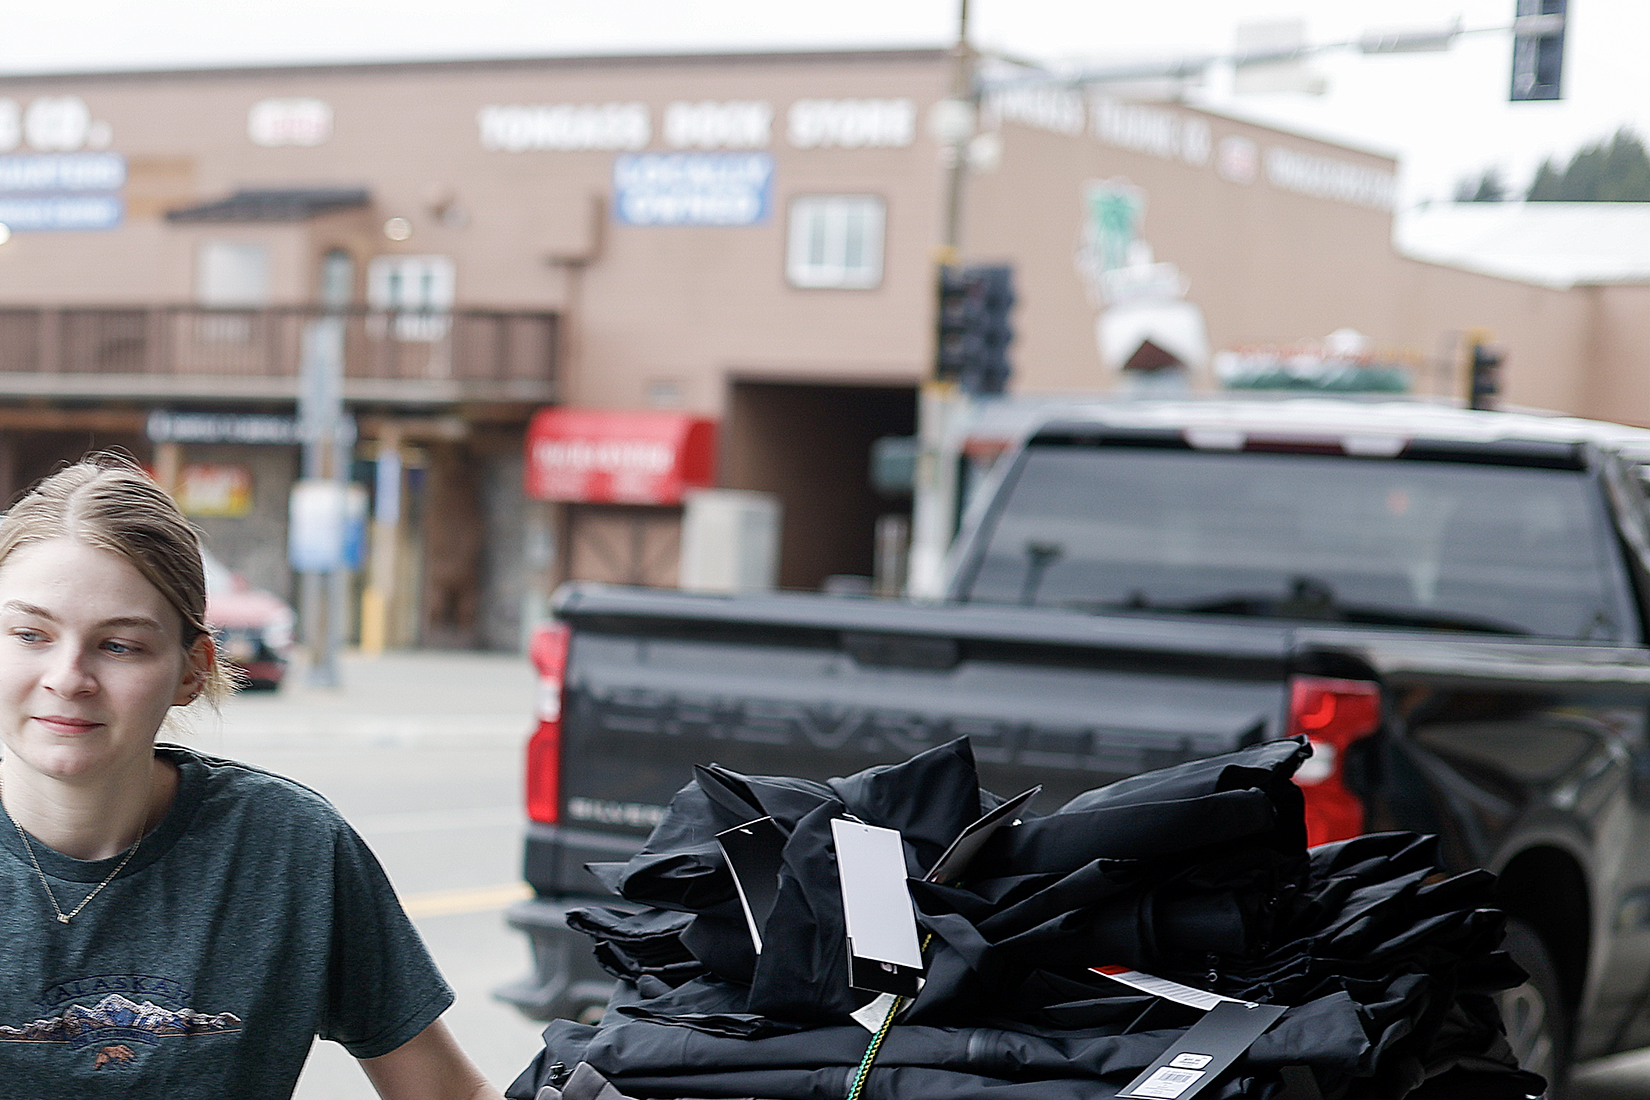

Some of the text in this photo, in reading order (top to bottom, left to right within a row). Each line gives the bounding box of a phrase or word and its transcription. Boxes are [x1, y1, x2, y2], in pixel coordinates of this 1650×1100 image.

[477, 103, 649, 151] TONGASS
[787, 99, 916, 147] STORE
[57, 977, 169, 997] ALASKA
